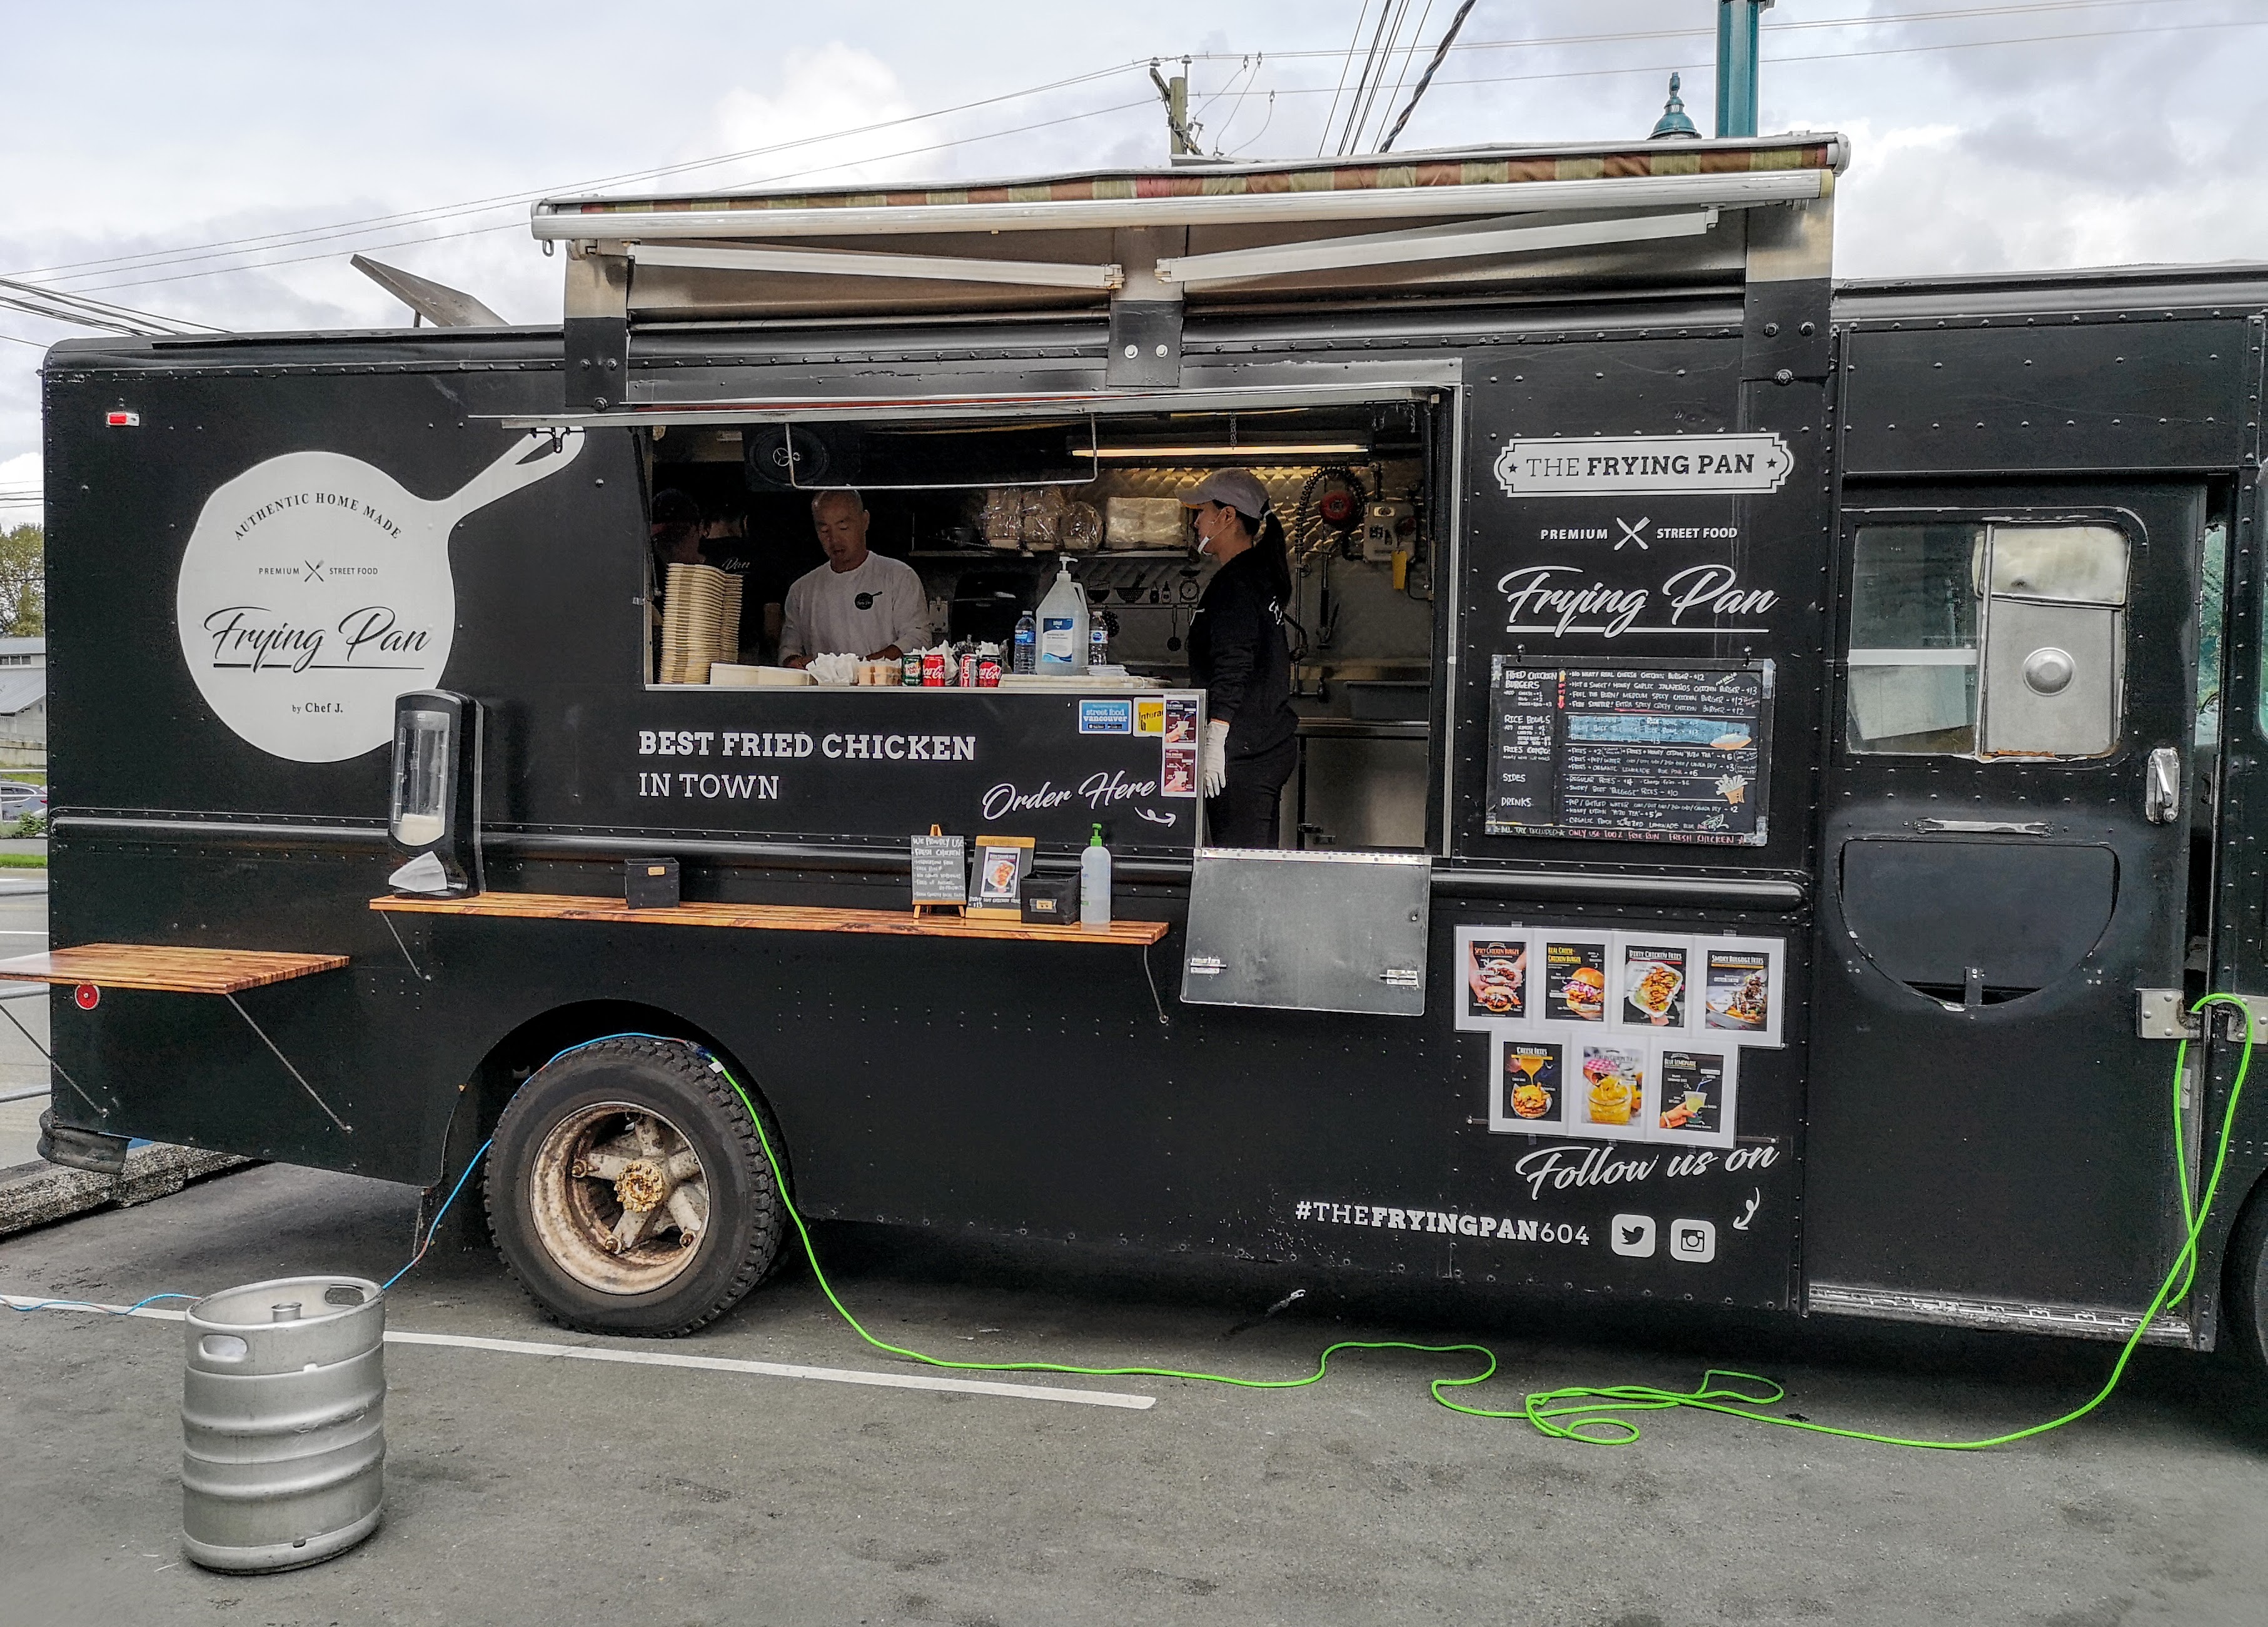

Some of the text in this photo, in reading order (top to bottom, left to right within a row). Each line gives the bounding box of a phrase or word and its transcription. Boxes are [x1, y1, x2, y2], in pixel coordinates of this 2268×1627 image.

[1526, 454, 1755, 477] THE FRYING PAN
[234, 493, 402, 540] AUTHENTIC HOME MADE
[1540, 529, 1608, 540] PREMIUM
[1656, 527, 1738, 539] STREET FOOD
[1498, 564, 1780, 638] Frying Pan
[203, 607, 431, 673] Frying Pan
[1528, 672, 1558, 680] CHICKEN
[1505, 680, 1540, 689] BURGERS
[292, 702, 343, 714] by Chef J.
[1086, 708, 1125, 716] street food
[1504, 714, 1551, 724] RICE BOWLS
[638, 730, 976, 760] BEST FRIED CHICKEN
[1503, 745, 1524, 753] FRIES
[1502, 773, 1526, 783] SIDES
[639, 773, 779, 799] IN TOWN
[982, 770, 1157, 820] Order Here
[1501, 797, 1532, 807] DRINKS
[1568, 829, 1587, 839] ONLY
[1668, 832, 1692, 842] FRESH
[925, 837, 950, 848] PROUDLY
[914, 848, 932, 856] FRESH
[1515, 1146, 1781, 1201] Follow us on
[1295, 1201, 1590, 1246] #THEFRYINGPAN604
